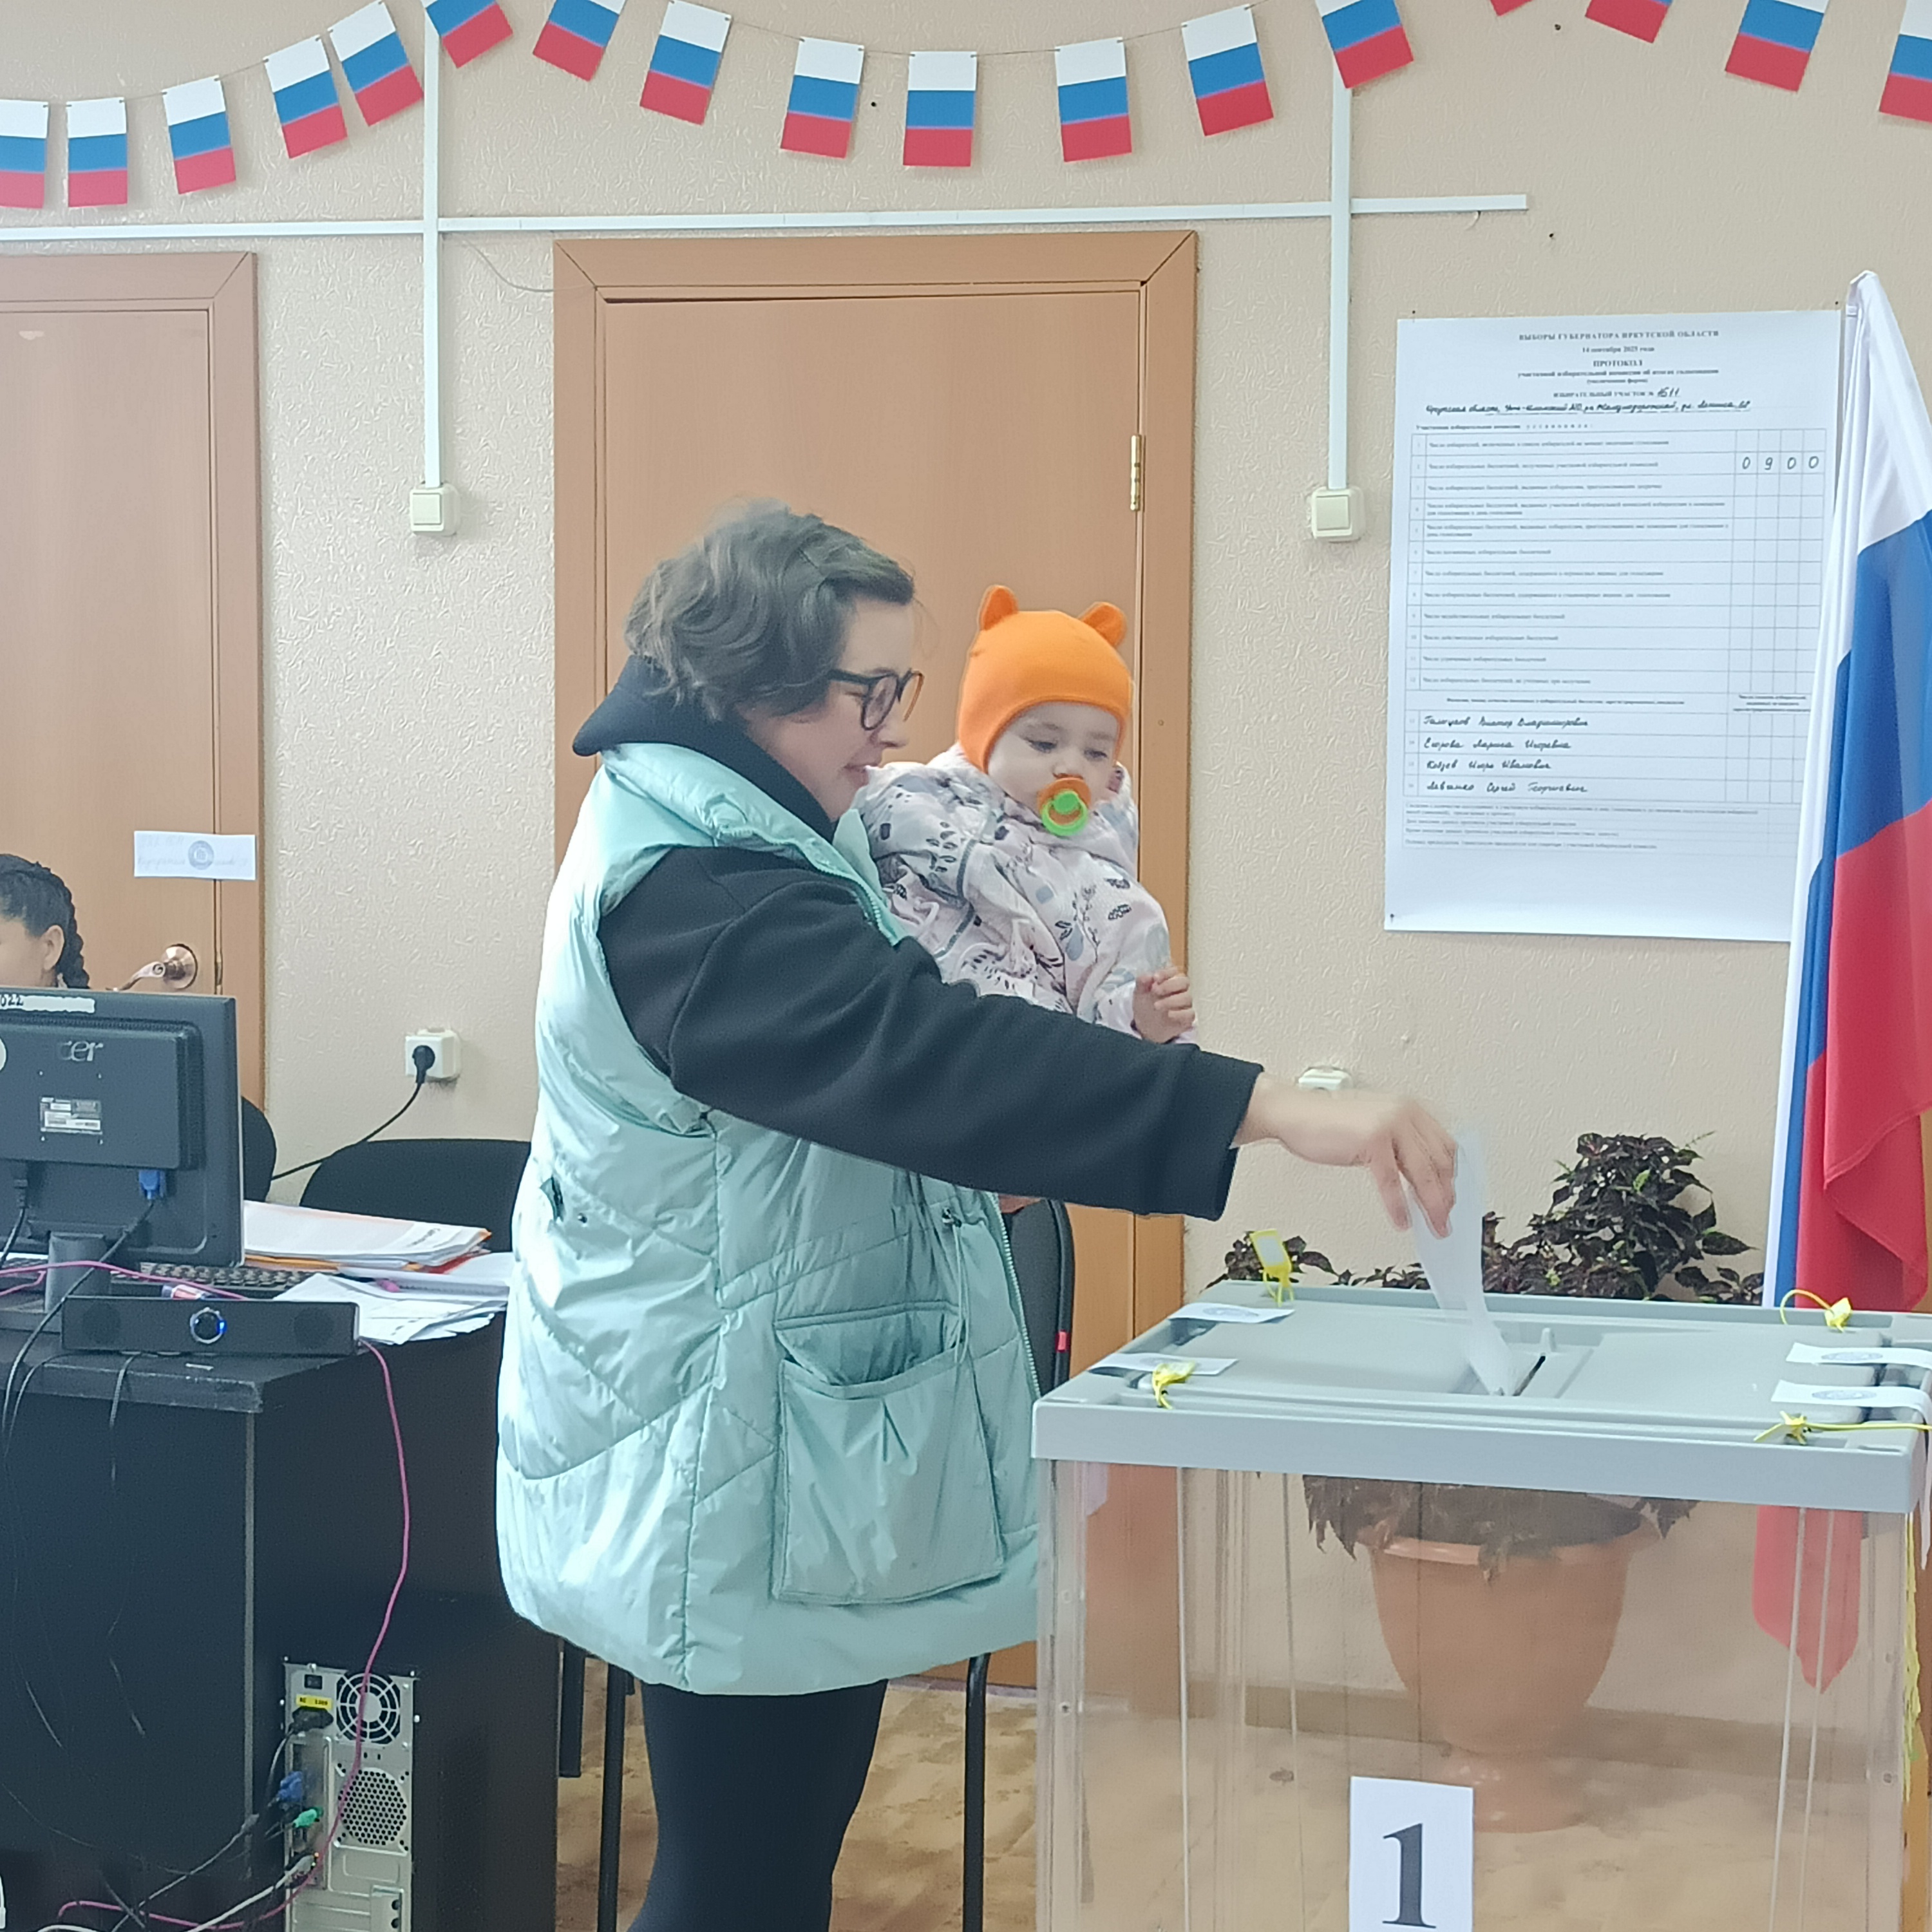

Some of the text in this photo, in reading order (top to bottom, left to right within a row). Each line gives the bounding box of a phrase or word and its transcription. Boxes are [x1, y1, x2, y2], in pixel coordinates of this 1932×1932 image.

[1742, 455, 1819, 470] 0 9 0 0
[1383, 1823, 1436, 1929] 1
